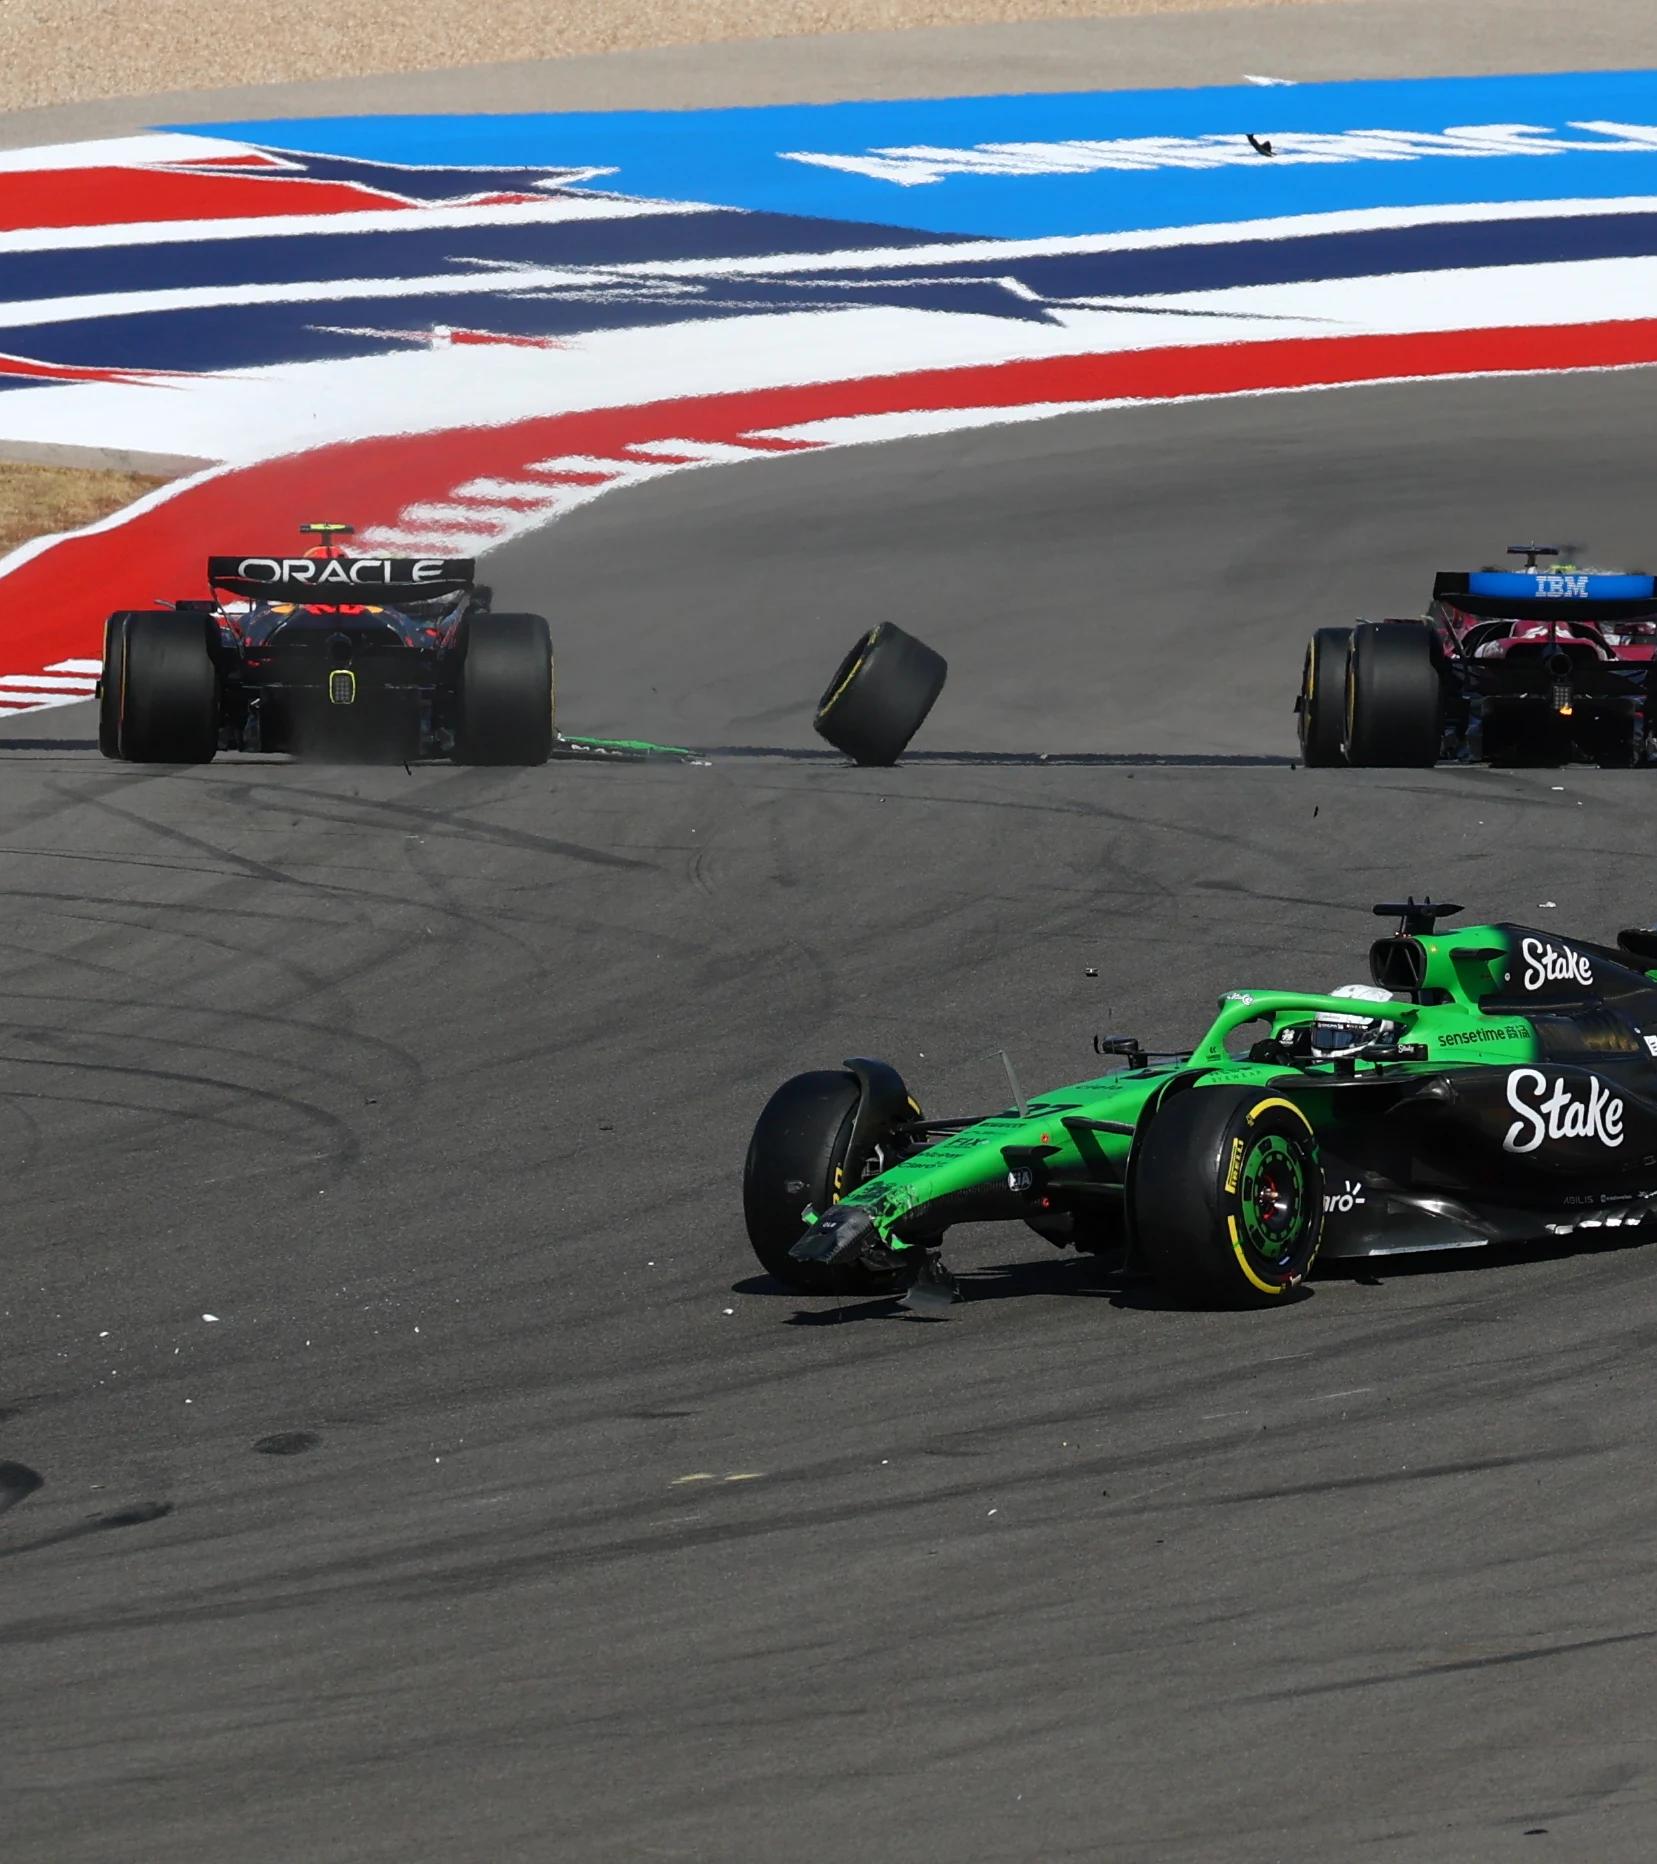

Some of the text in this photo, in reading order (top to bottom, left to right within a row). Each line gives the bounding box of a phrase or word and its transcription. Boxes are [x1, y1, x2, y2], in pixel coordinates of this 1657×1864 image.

[238, 559, 445, 584] ORACLE
[1534, 574, 1589, 599] IBM
[1521, 937, 1594, 991] Stake
[1437, 1028, 1506, 1047] sensetime
[1503, 1068, 1624, 1154] Stake
